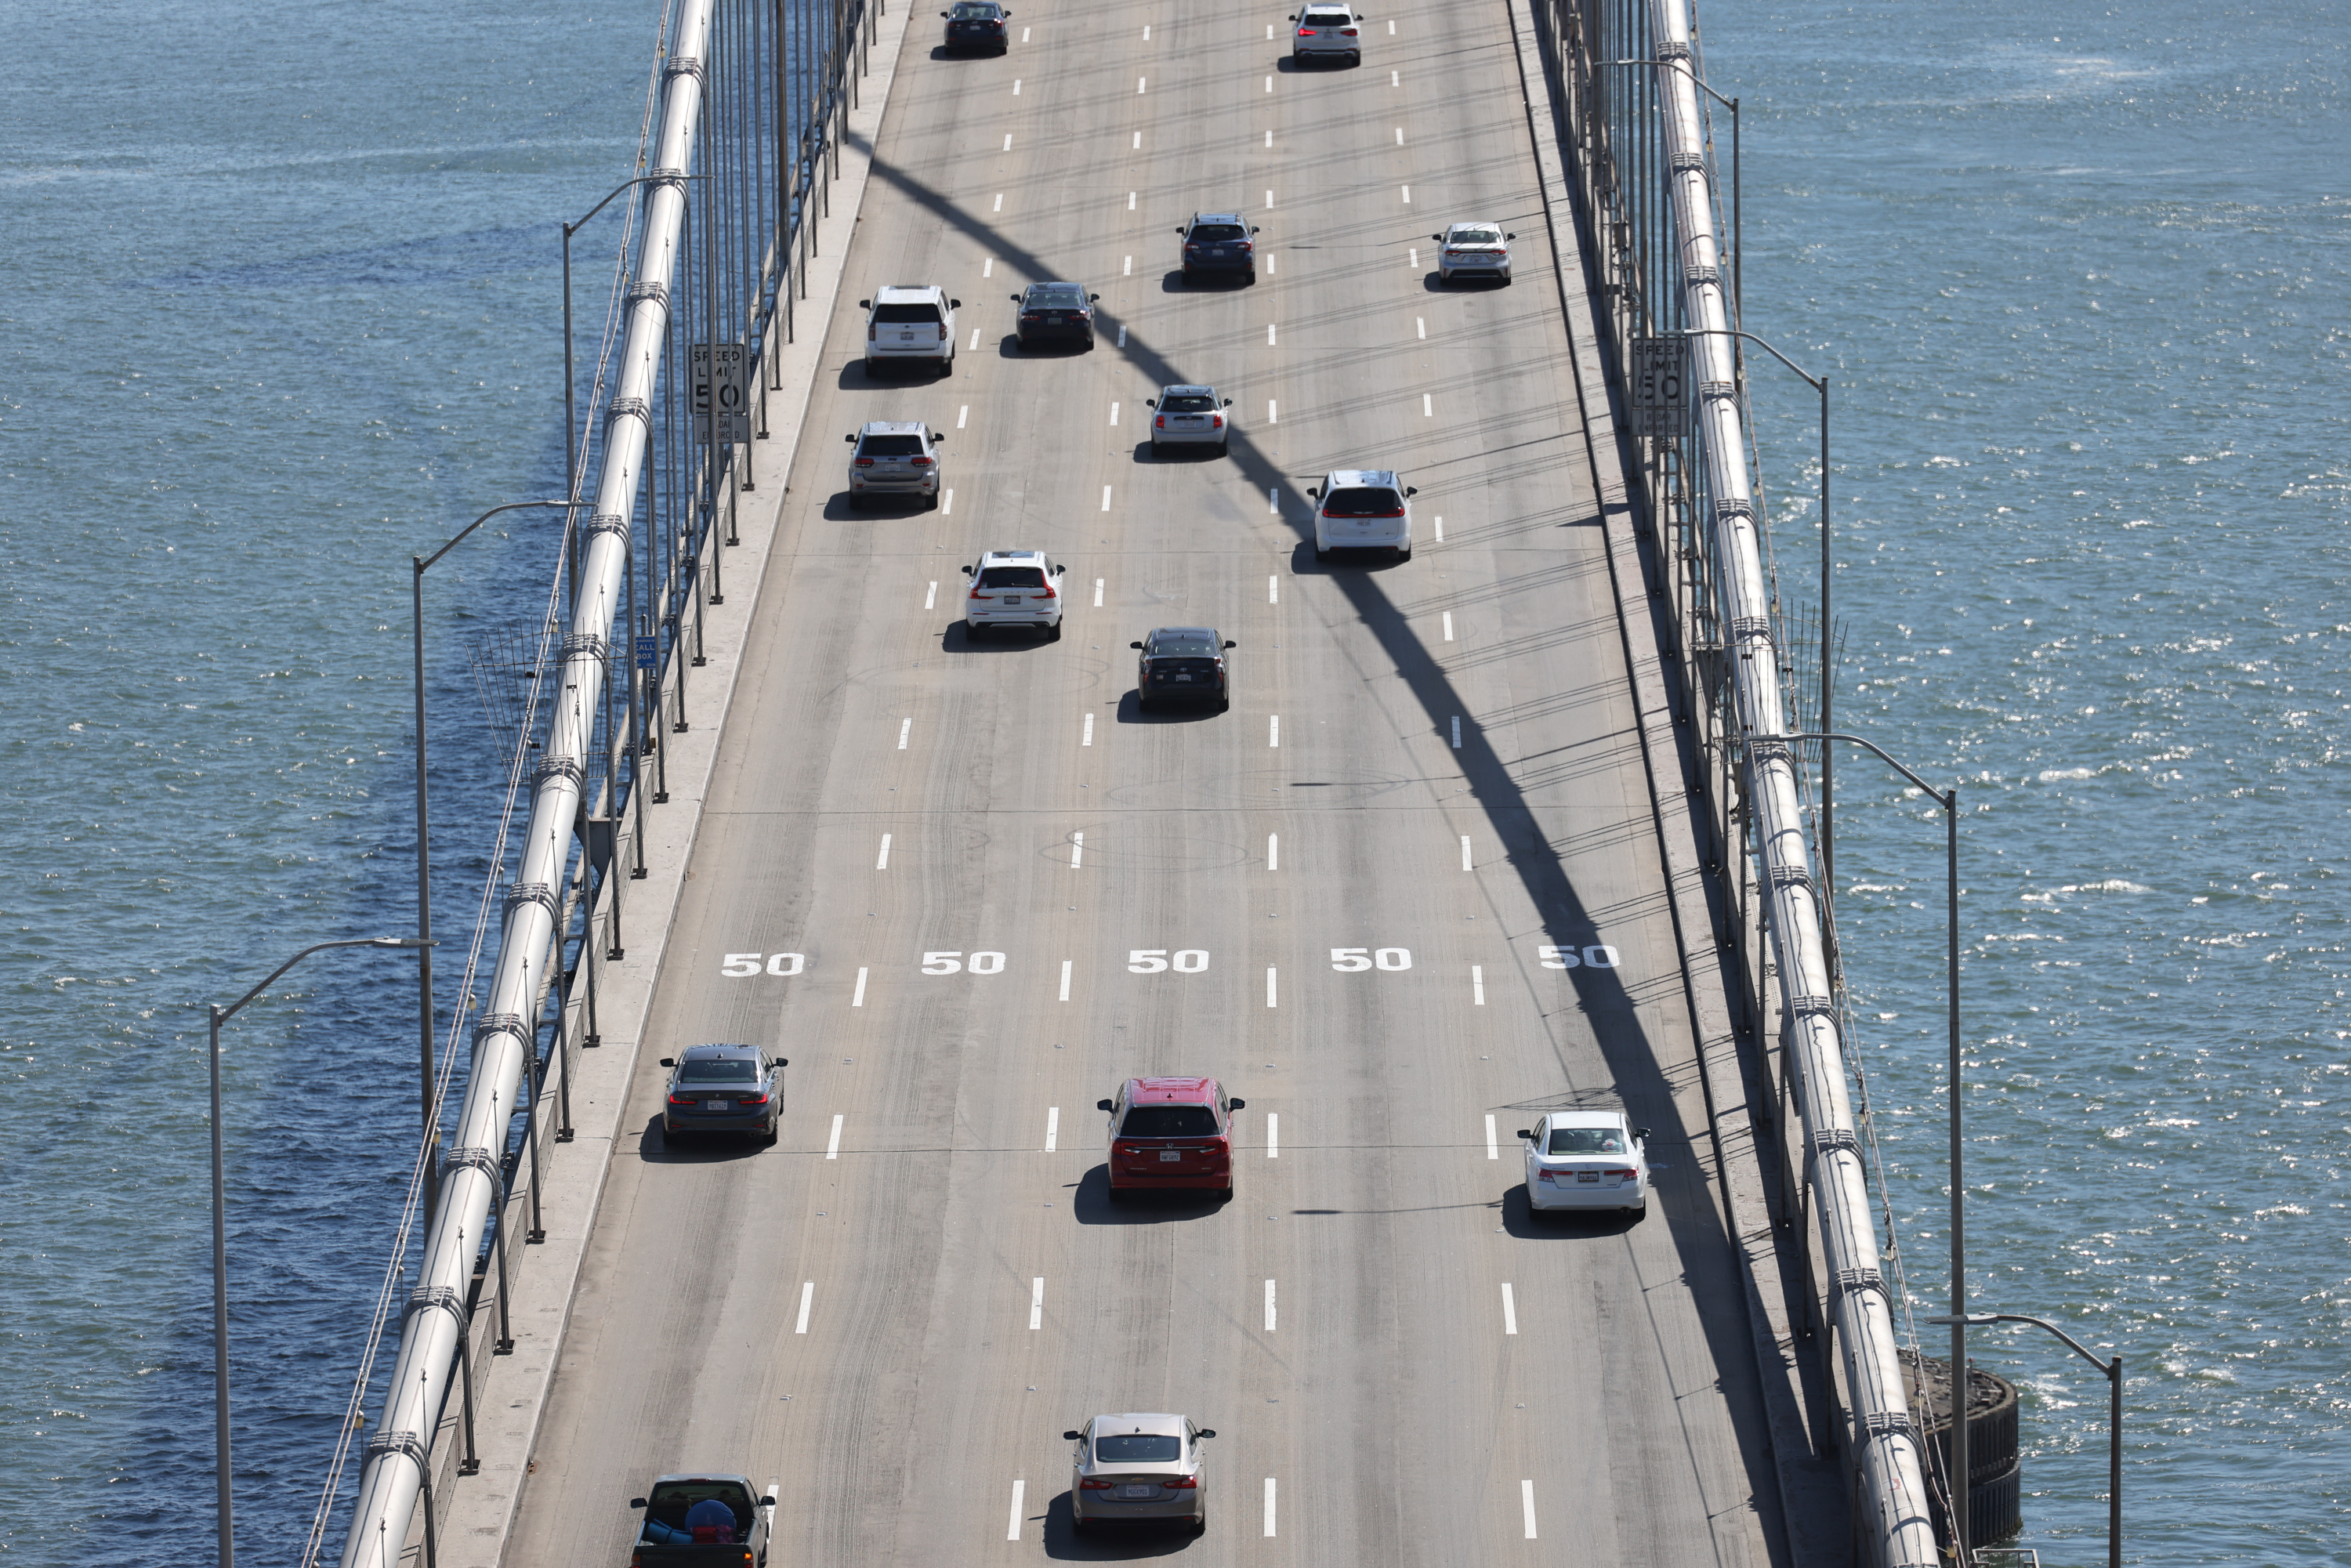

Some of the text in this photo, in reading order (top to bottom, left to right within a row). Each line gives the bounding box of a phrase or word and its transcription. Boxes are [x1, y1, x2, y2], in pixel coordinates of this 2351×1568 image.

[697, 367, 737, 378] LMIT
[695, 383, 740, 409] 50
[1637, 375, 1680, 400] 50
[1646, 413, 1672, 422] RDAR
[720, 952, 806, 977] 50
[921, 951, 1008, 976] 50
[1128, 949, 1210, 974] 50
[1330, 947, 1413, 972] 50
[1538, 945, 1621, 972] 50
